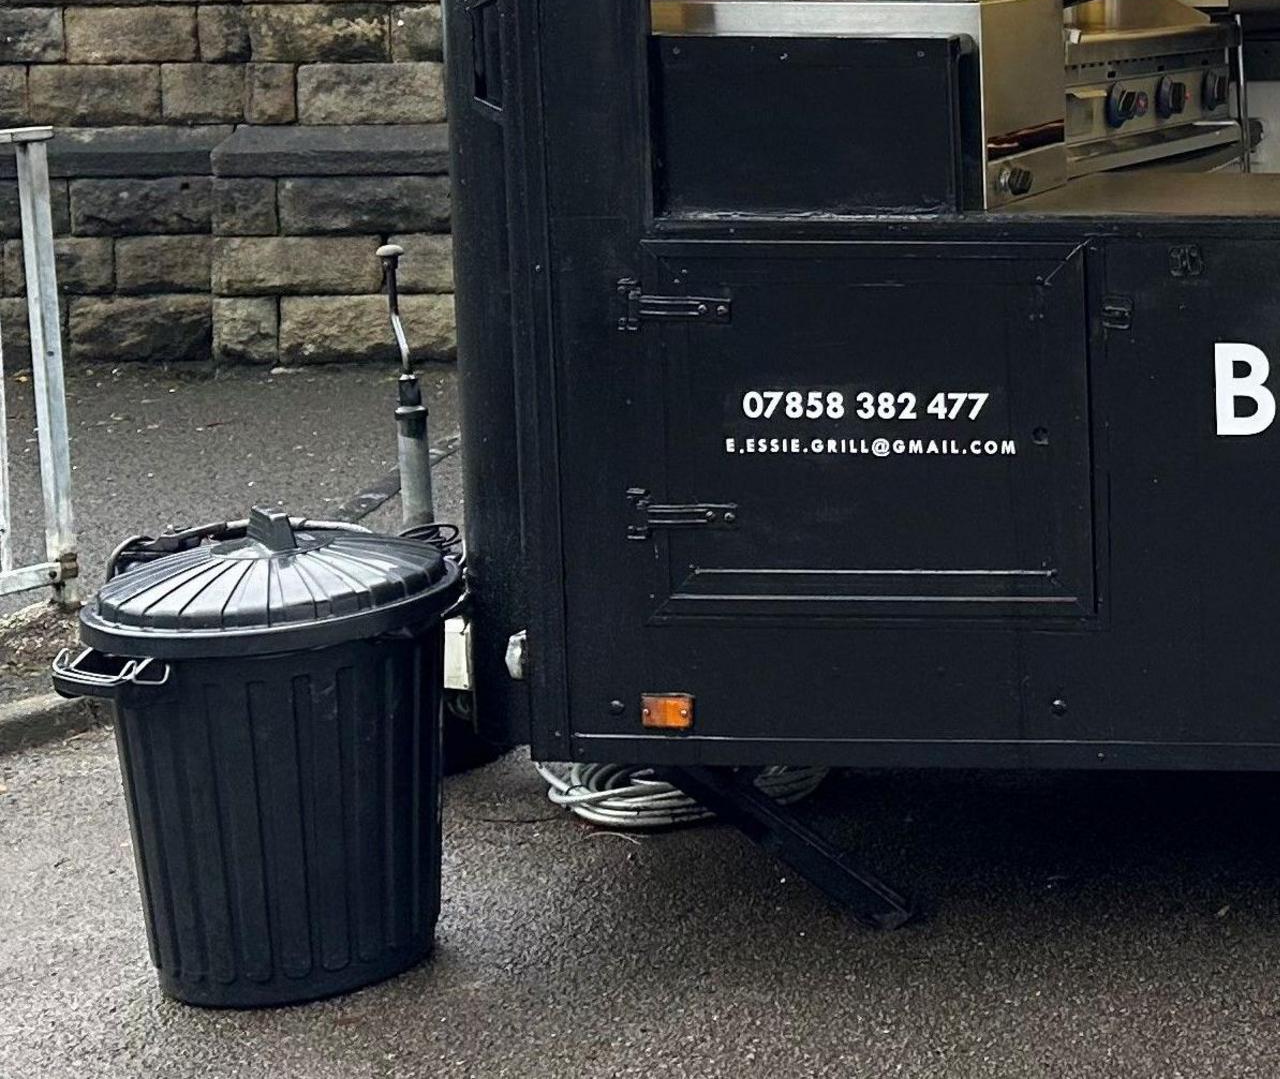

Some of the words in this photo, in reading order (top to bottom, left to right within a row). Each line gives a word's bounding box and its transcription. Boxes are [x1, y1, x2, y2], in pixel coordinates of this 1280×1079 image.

[743, 391, 844, 419] 07858
[856, 391, 917, 419] 382
[927, 392, 989, 420] 477
[726, 438, 1016, 457] E.ESSIE.GRILL@GMAIL.COM
